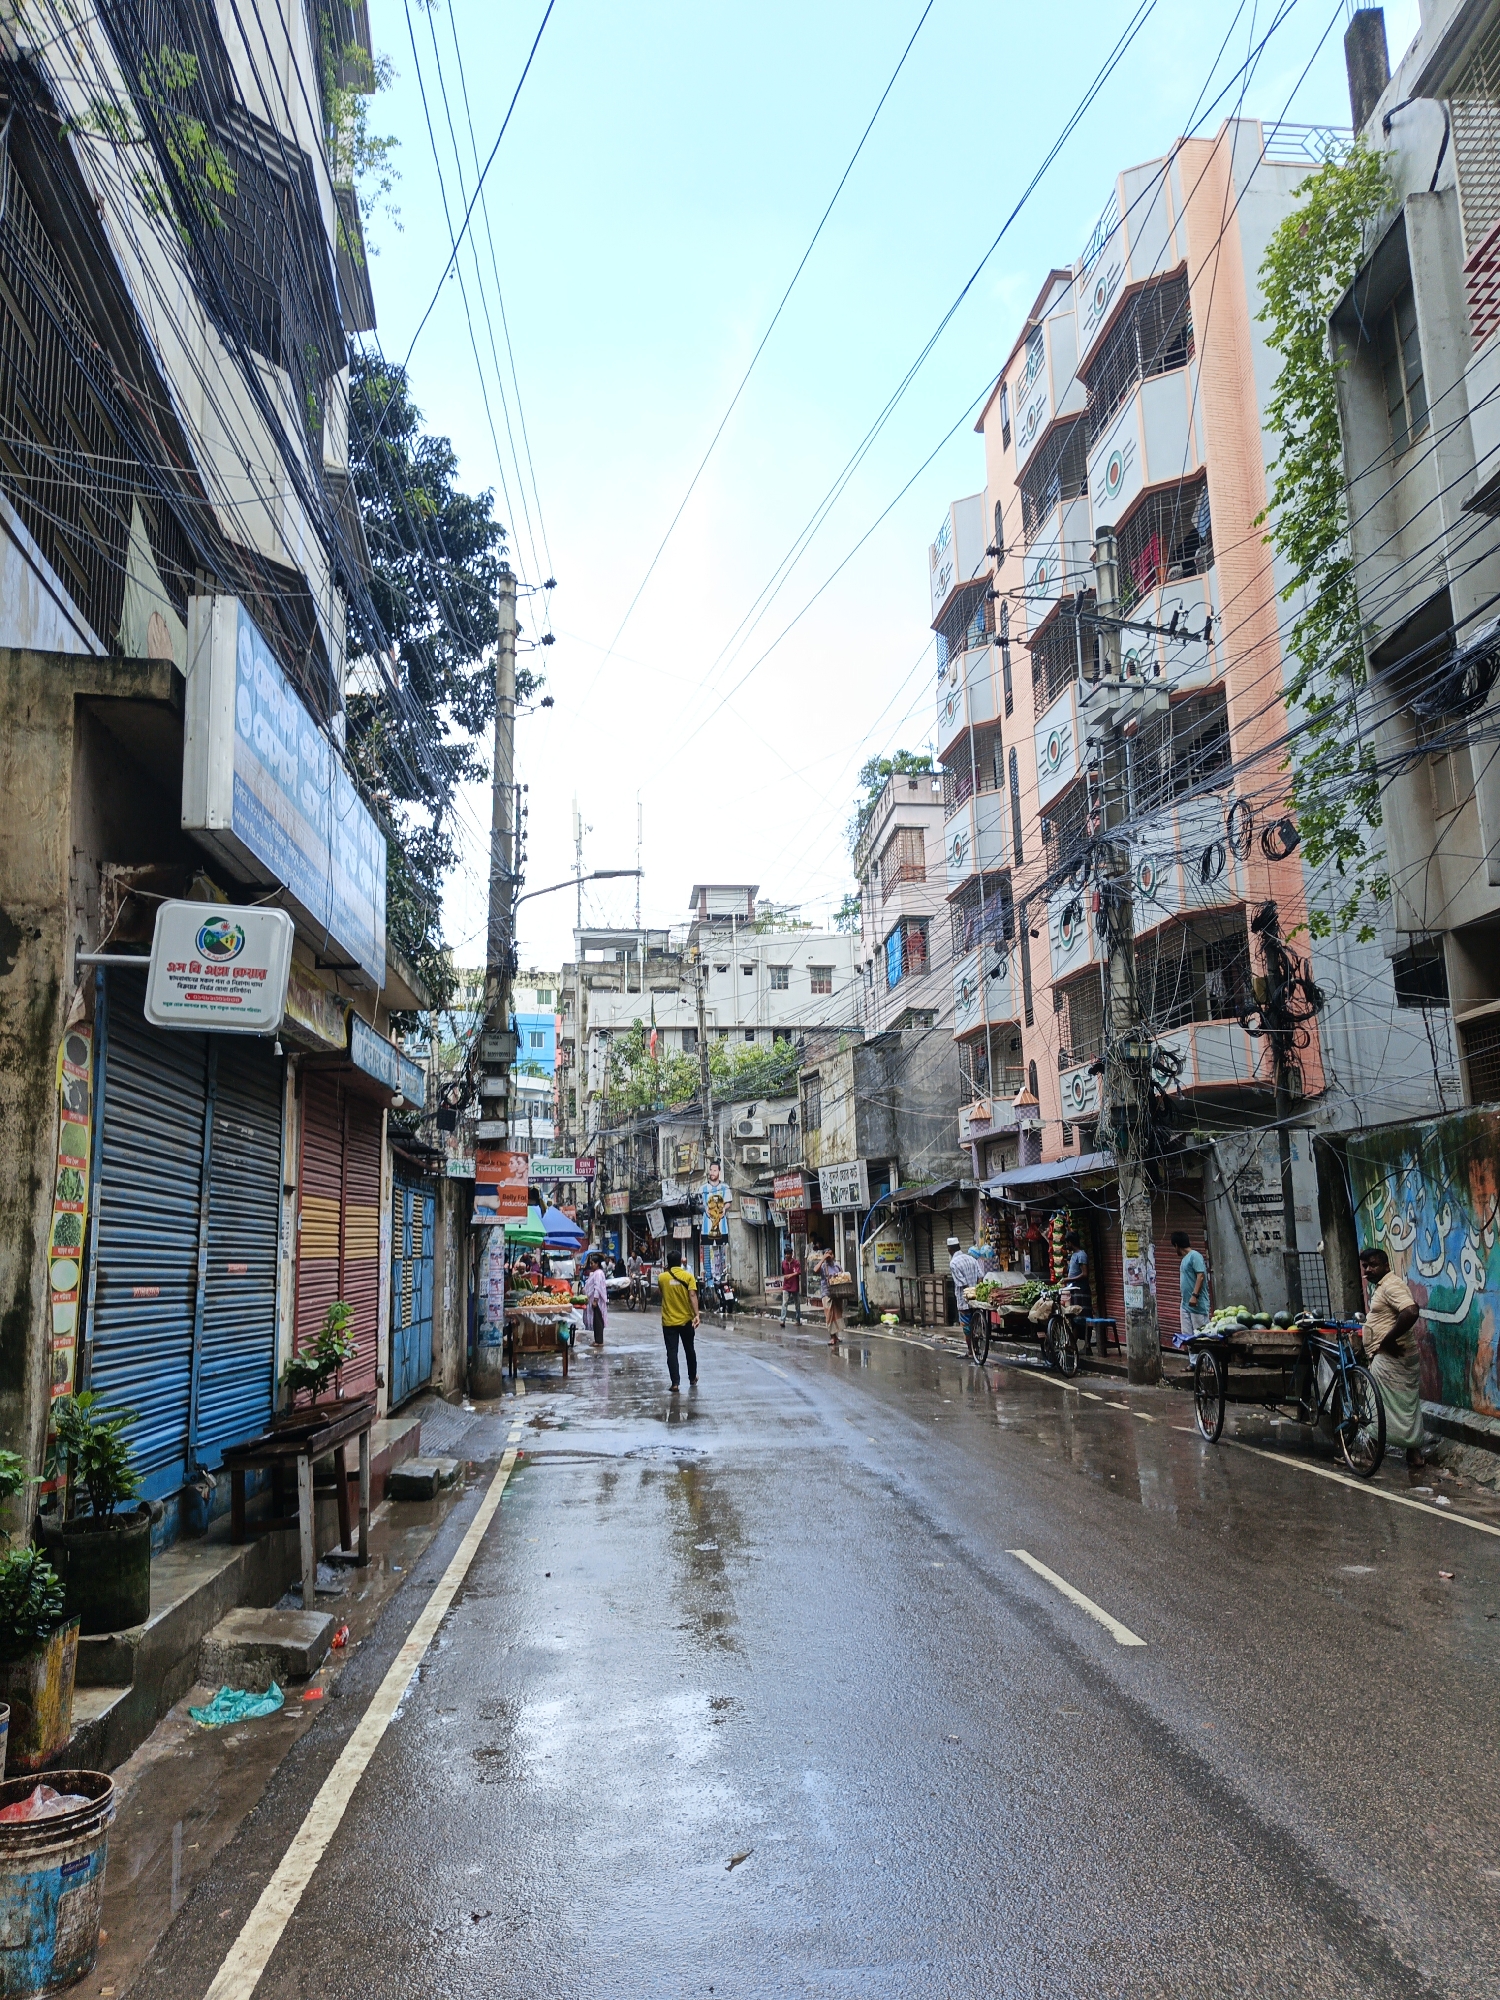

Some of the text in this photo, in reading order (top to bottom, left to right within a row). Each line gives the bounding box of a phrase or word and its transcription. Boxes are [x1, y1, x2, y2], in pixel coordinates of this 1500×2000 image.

[167, 962, 186, 973] এস
[189, 960, 201, 974] বি
[233, 967, 268, 980] কেয়ার
[531, 1161, 573, 1175] বিদ্যালয়
